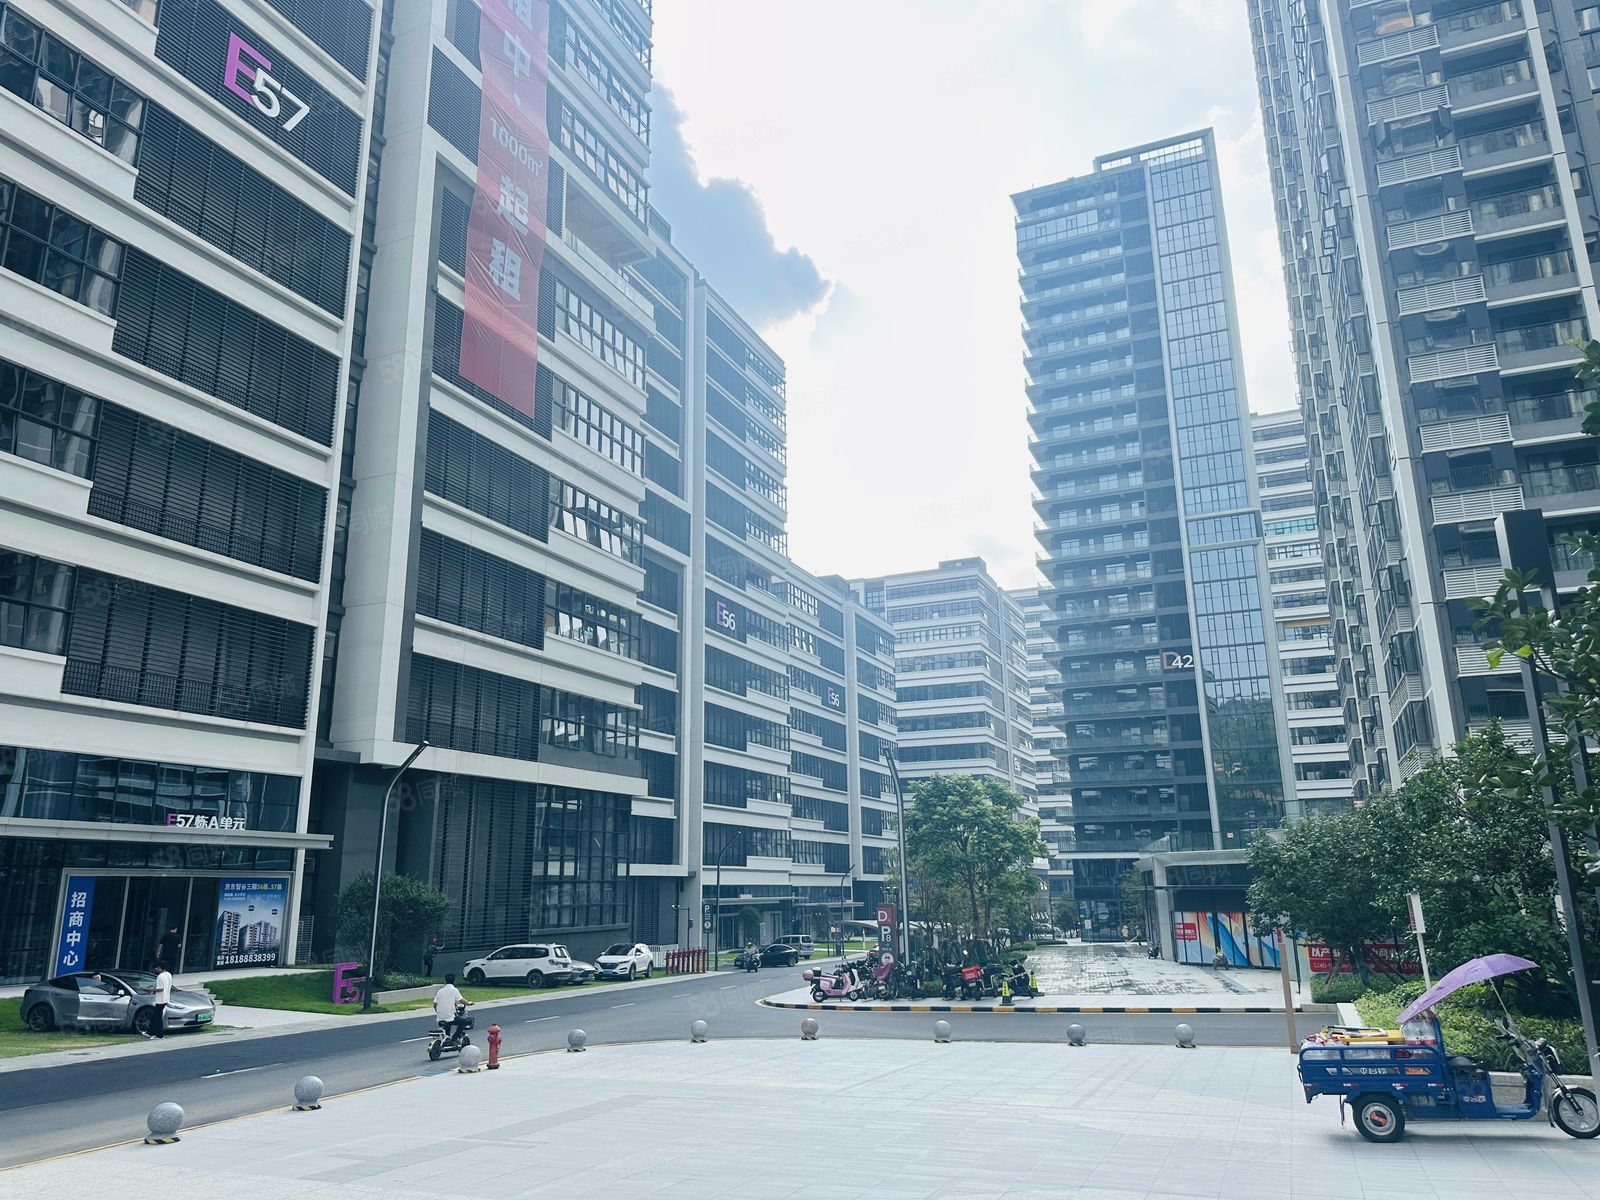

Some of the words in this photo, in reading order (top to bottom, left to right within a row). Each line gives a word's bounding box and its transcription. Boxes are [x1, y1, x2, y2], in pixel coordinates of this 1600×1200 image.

[223, 31, 310, 132] E57
[716, 600, 736, 631] E56
[1162, 652, 1194, 669] D42
[827, 687, 840, 707] E56
[167, 813, 246, 831] E57栋A单元
[63, 891, 87, 967] 招商中心
